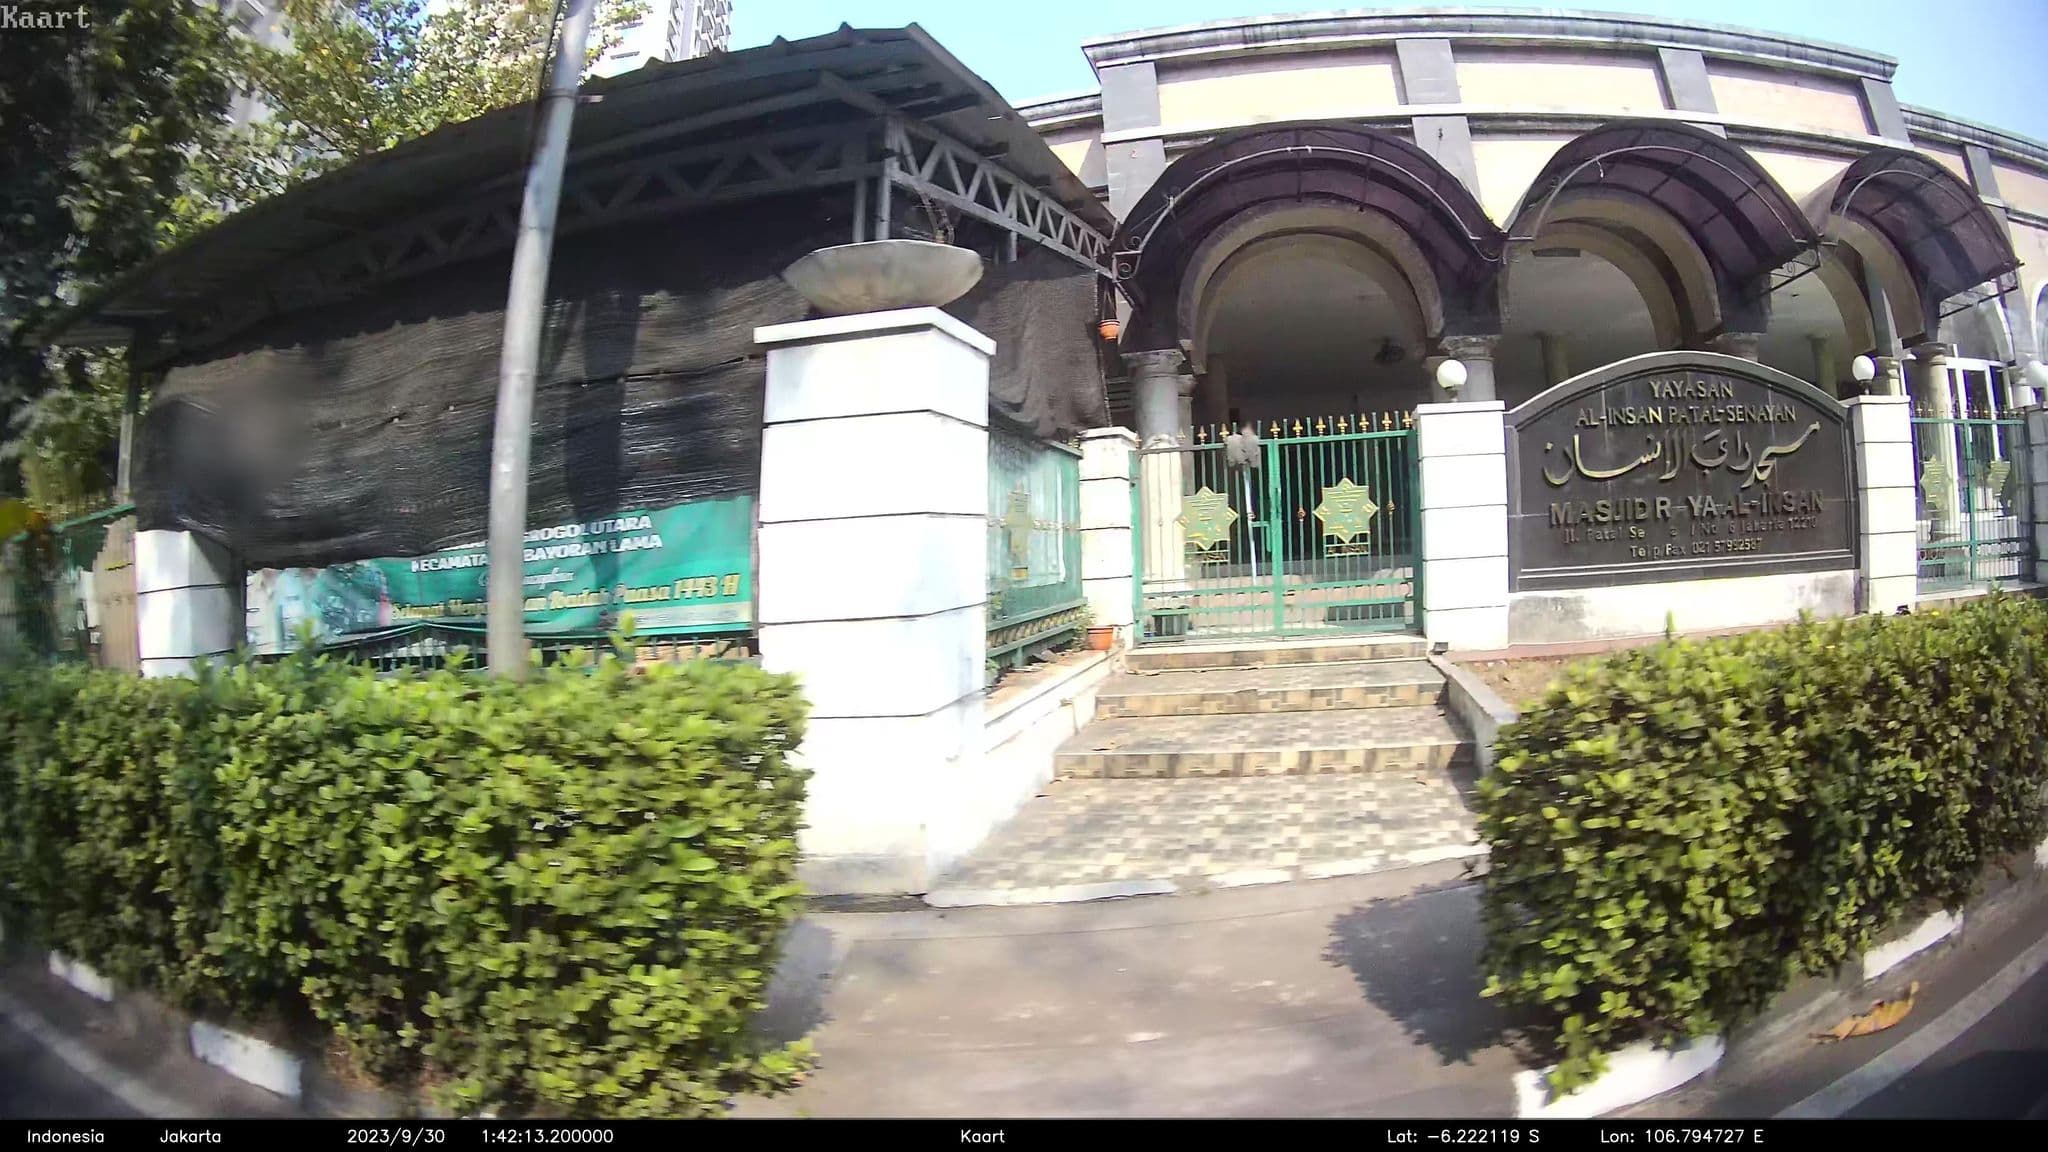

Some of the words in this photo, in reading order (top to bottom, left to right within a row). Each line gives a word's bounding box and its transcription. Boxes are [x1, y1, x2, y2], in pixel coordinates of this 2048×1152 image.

[1650, 380, 1734, 398] YAYASAN
[1576, 406, 1663, 427] AL-INSAN
[1668, 404, 1798, 424] PATAL-SENAYAN
[1550, 498, 1649, 526] MASJID
[589, 514, 652, 535] UTARA
[411, 553, 488, 573] KECAMATA
[611, 534, 663, 552] LAMA
[673, 575, 719, 600] 1443
